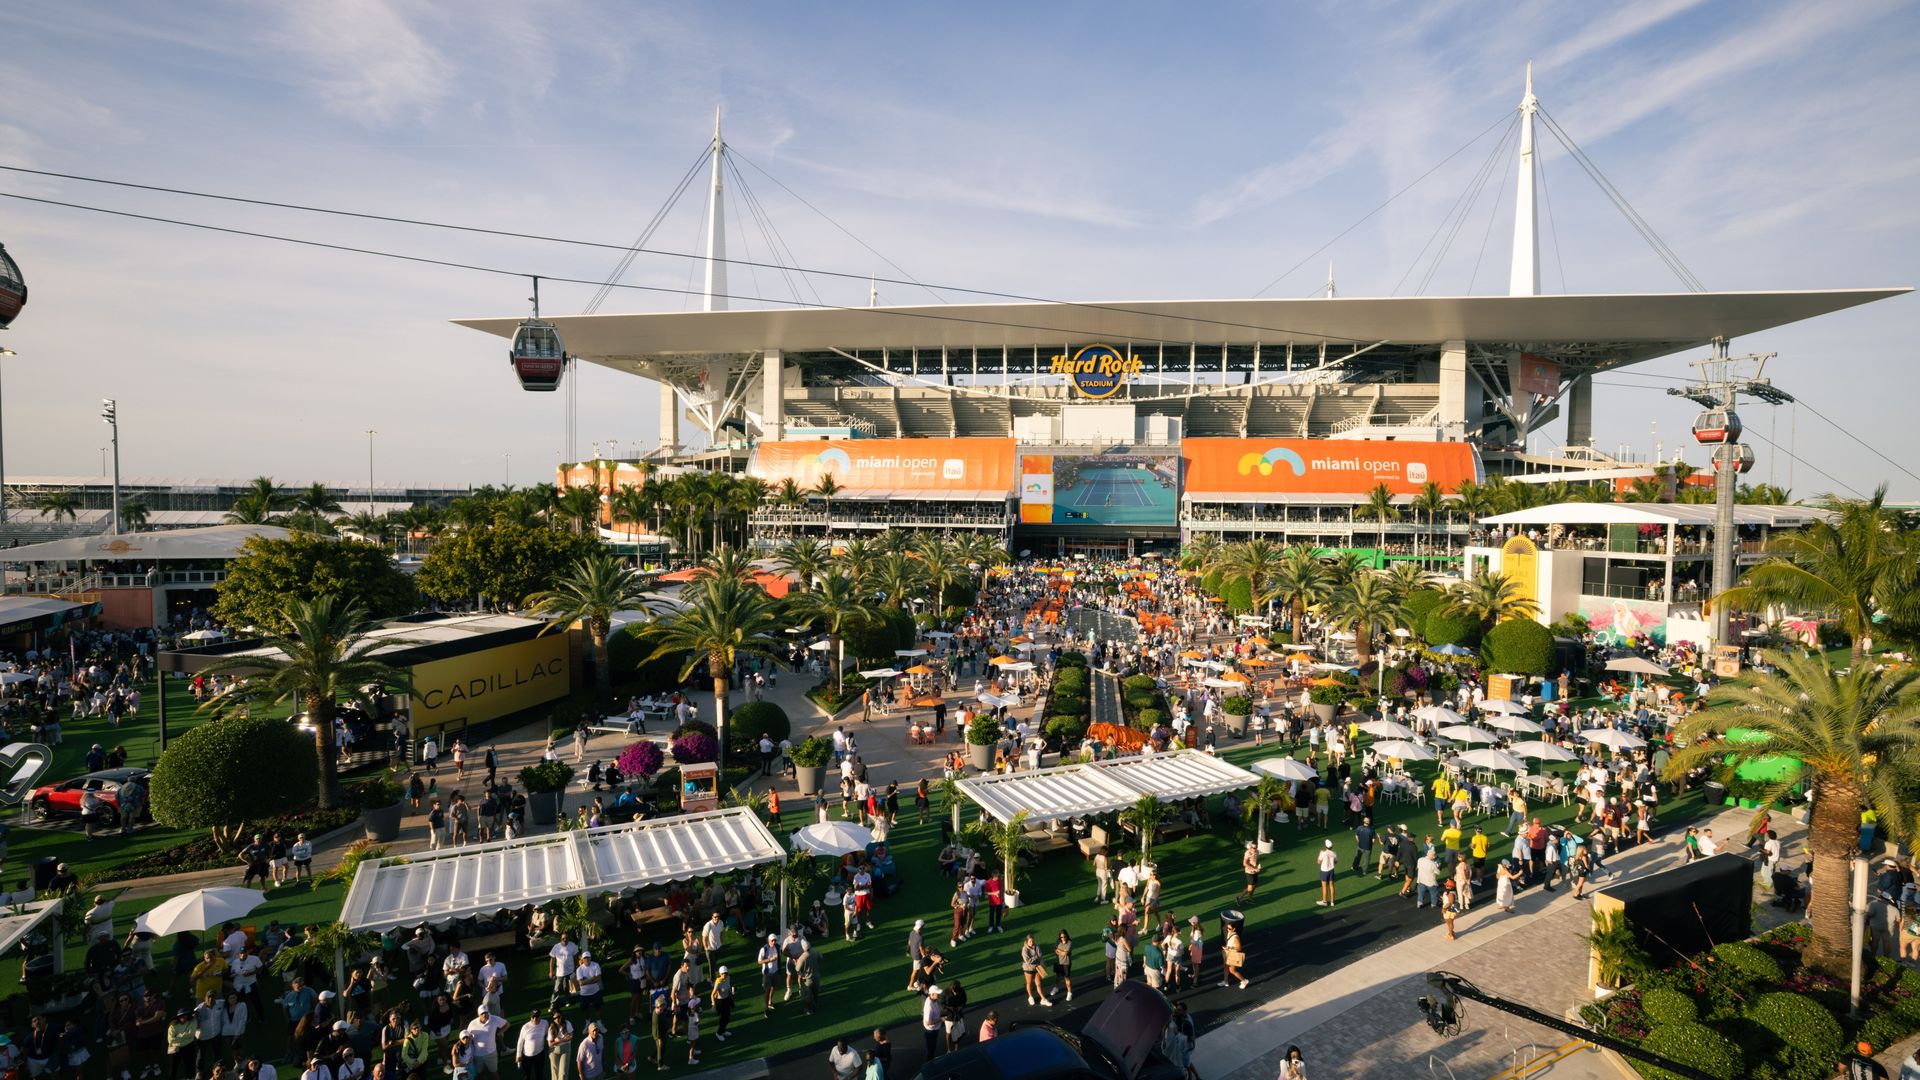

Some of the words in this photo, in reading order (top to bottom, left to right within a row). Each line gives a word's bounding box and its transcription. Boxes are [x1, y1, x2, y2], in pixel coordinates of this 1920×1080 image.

[1050, 354, 1097, 375] Hard
[1098, 354, 1143, 377] Rock
[856, 456, 900, 468] miami
[902, 458, 937, 471] open
[1311, 457, 1360, 470] miami
[1363, 460, 1400, 474] open
[424, 658, 562, 709] CADILLAC
